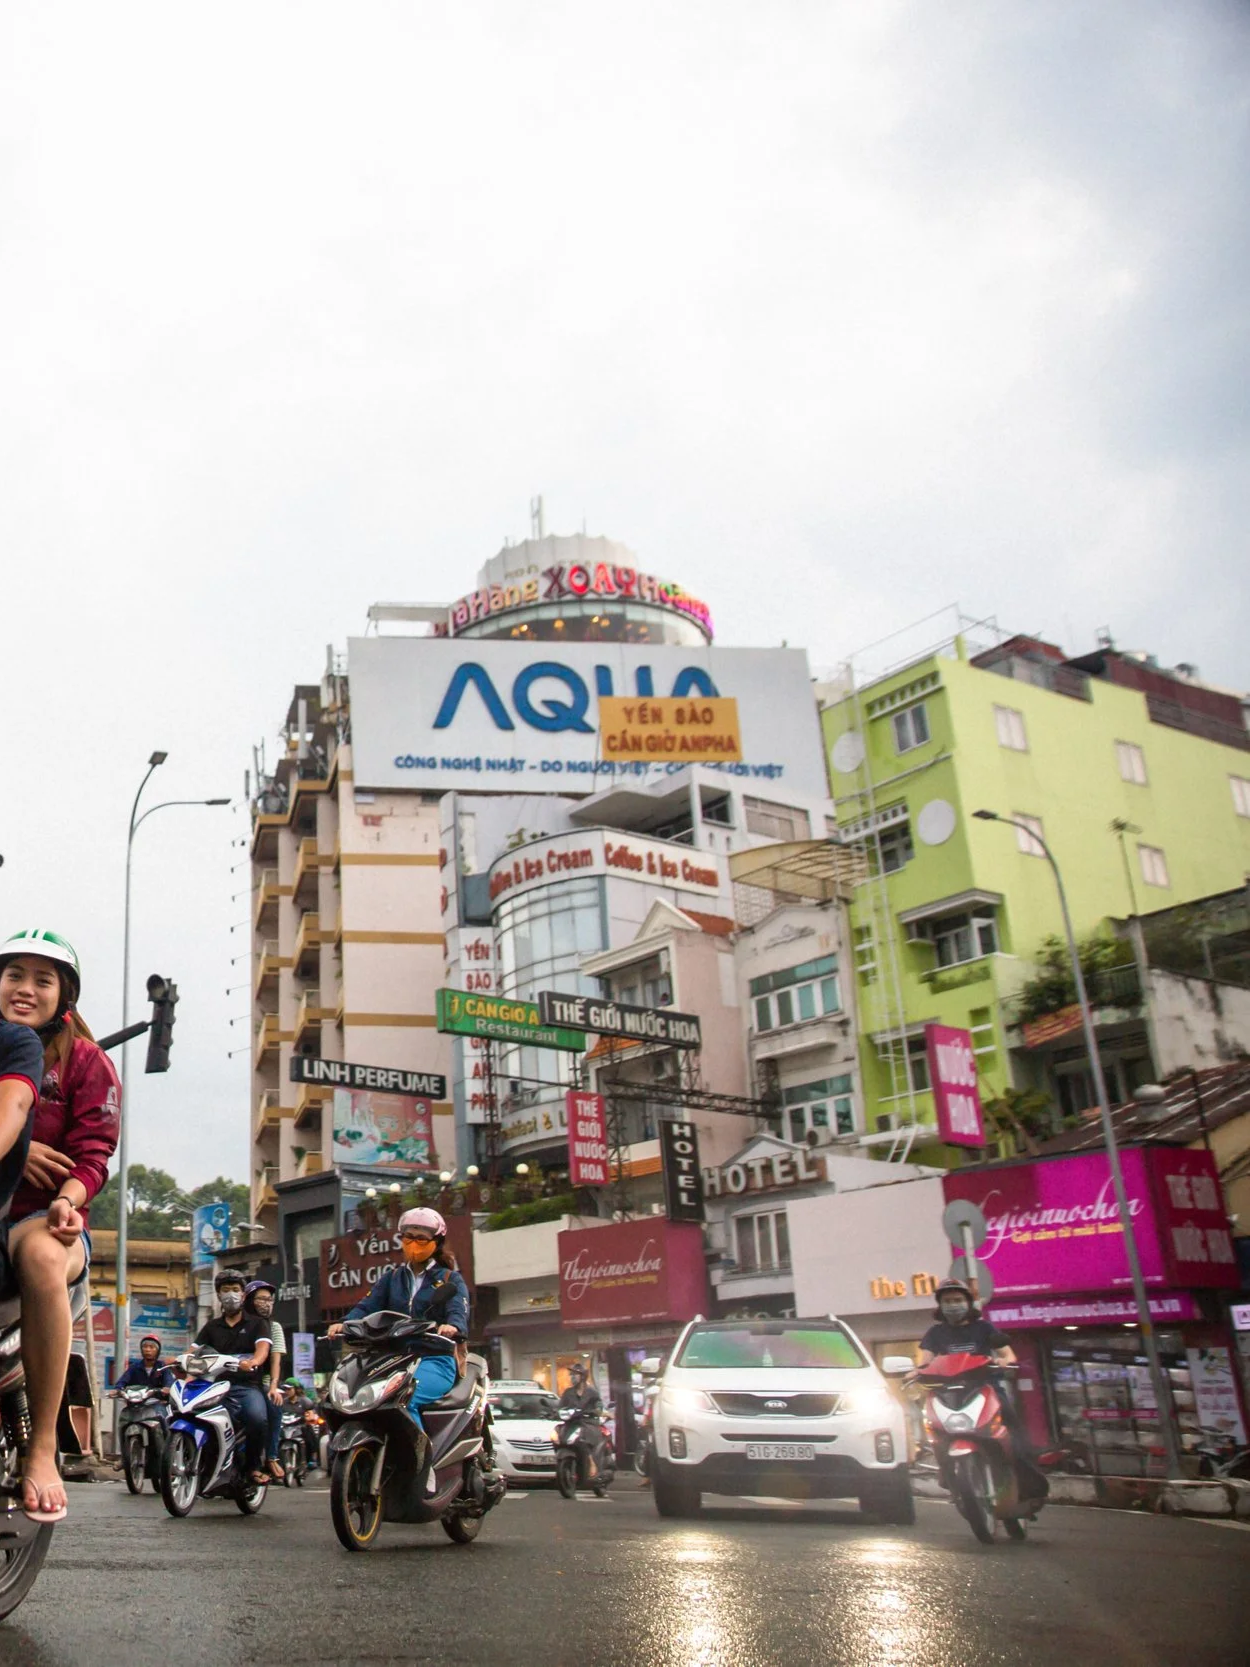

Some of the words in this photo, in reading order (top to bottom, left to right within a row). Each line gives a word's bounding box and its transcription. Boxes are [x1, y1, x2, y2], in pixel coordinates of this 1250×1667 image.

[395, 754, 437, 769] CÔNG
[547, 848, 593, 873] Cream
[476, 1018, 557, 1042] Restaurant
[552, 997, 587, 1025] THẾ
[669, 1021, 700, 1043] HOA
[303, 1060, 350, 1083] LINH
[354, 1067, 441, 1095] PERFUME
[575, 1096, 599, 1118] THẾ
[577, 1120, 602, 1138] GIỚI
[574, 1139, 608, 1160] NƯỚC
[579, 1163, 605, 1181] HOA
[671, 1124, 697, 1206] HOTEL
[702, 1150, 818, 1198] HOTEL
[357, 1233, 389, 1256] Yến
[328, 1264, 362, 1290] CẦN
[870, 1276, 907, 1300] the
[989, 1299, 1183, 1323] www.thegioinuochoa.cm.vn
